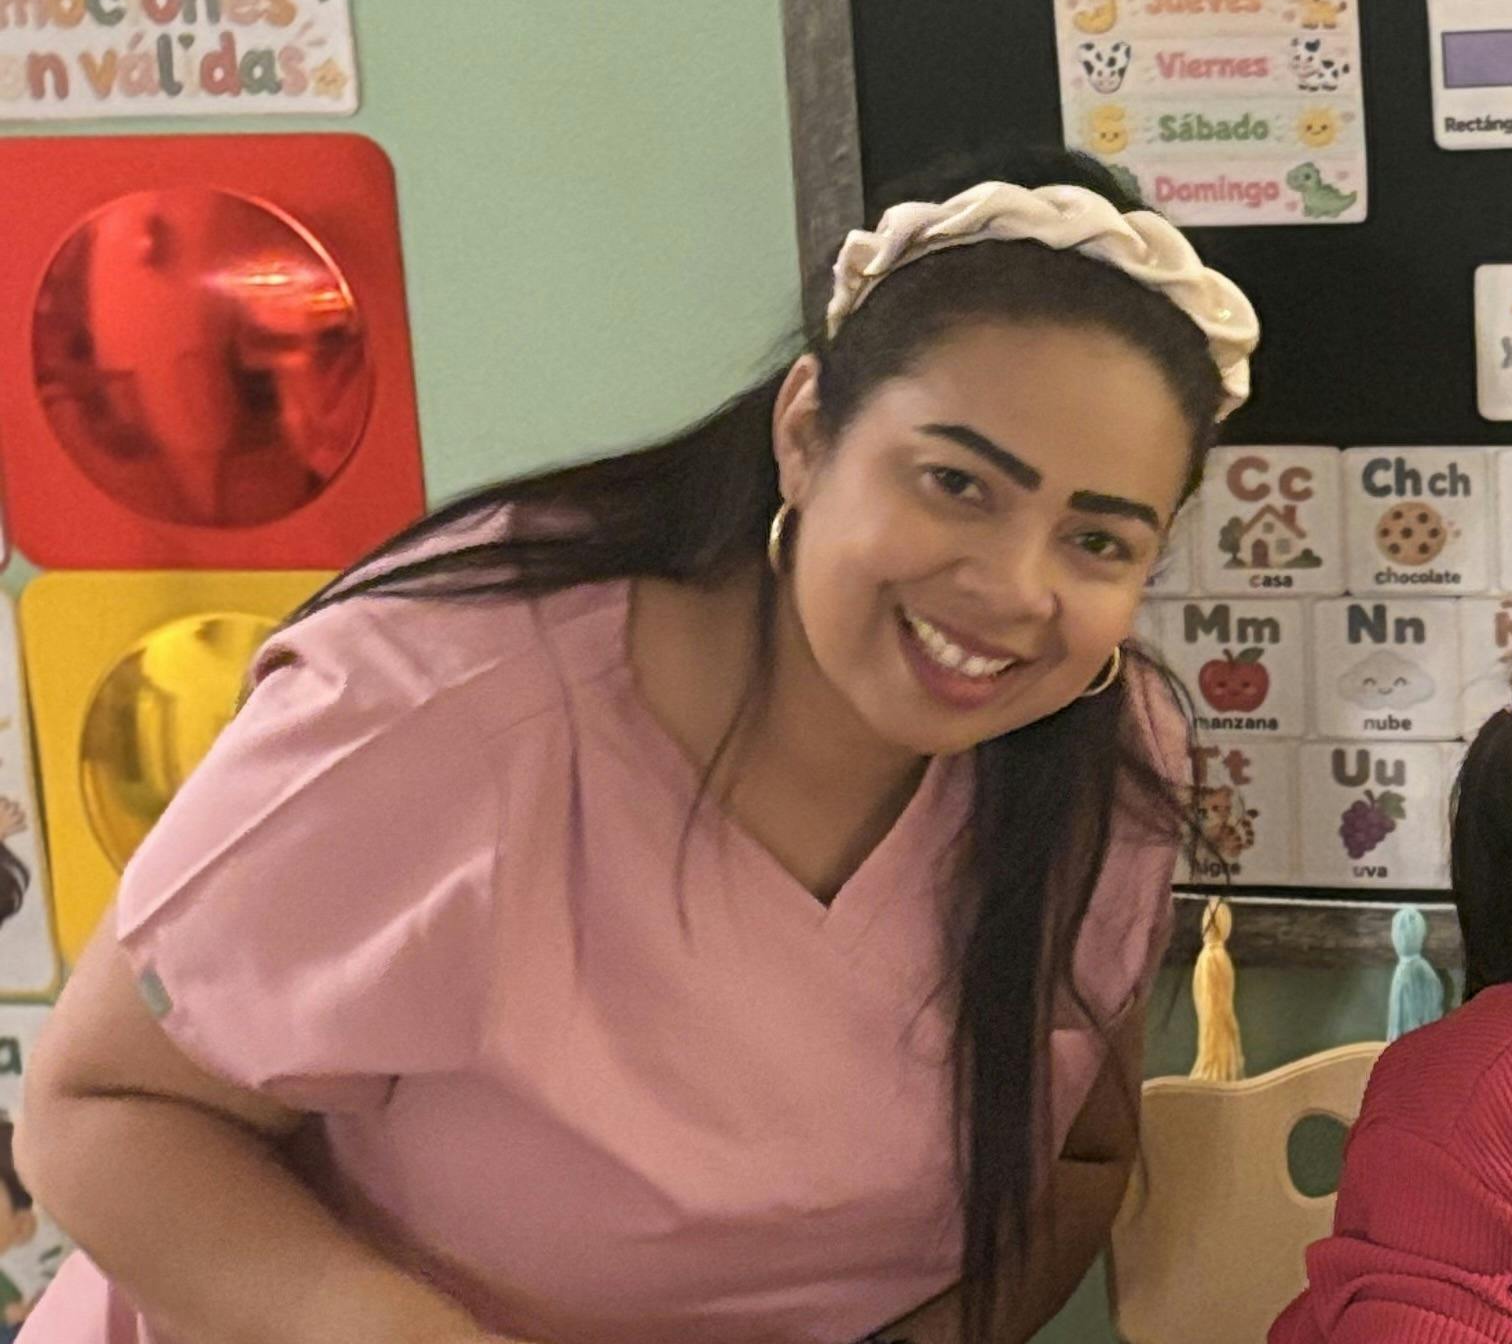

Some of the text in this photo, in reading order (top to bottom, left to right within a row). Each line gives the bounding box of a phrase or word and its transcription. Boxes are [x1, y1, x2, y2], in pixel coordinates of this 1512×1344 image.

[1156, 50, 1269, 79] Viernes
[1159, 112, 1270, 143] Sábado
[1155, 174, 1280, 209] Domingo
[1225, 455, 1314, 503] Cc
[1249, 573, 1294, 589] casa
[1375, 567, 1462, 586] chocolate
[1183, 603, 1281, 645] Mm
[1346, 603, 1426, 645] Nn
[1363, 715, 1413, 731] nube
[1187, 744, 1252, 786] Tt
[1331, 747, 1406, 788] Uu
[1353, 863, 1388, 879] uva
